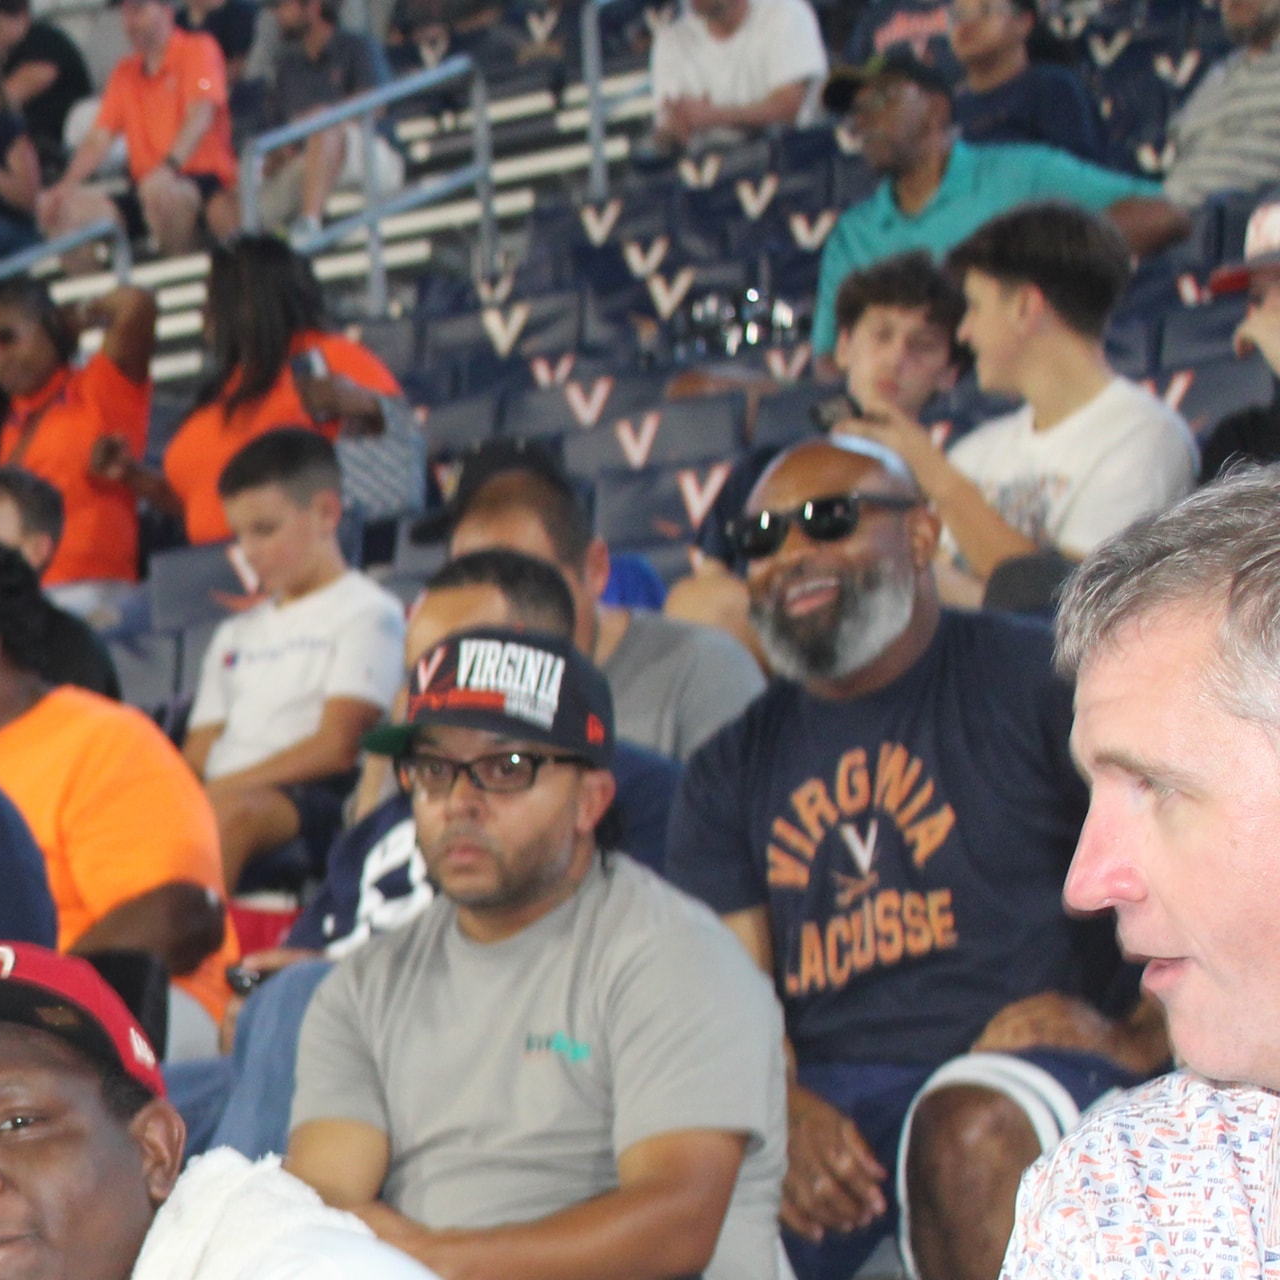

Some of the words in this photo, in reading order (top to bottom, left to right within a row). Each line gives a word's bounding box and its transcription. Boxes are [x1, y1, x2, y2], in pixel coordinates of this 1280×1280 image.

[1088, 28, 1132, 67] V
[581, 199, 623, 247] V
[737, 173, 779, 219] V
[624, 235, 669, 278] V
[790, 208, 837, 251] V
[647, 266, 695, 320] V
[482, 303, 531, 358] V
[564, 376, 614, 427] V
[615, 411, 662, 468] V
[677, 463, 732, 529] V
[417, 645, 448, 696] V
[456, 638, 566, 704] VIRGINIA
[767, 742, 956, 888] VIRGNIA
[842, 818, 878, 875] V
